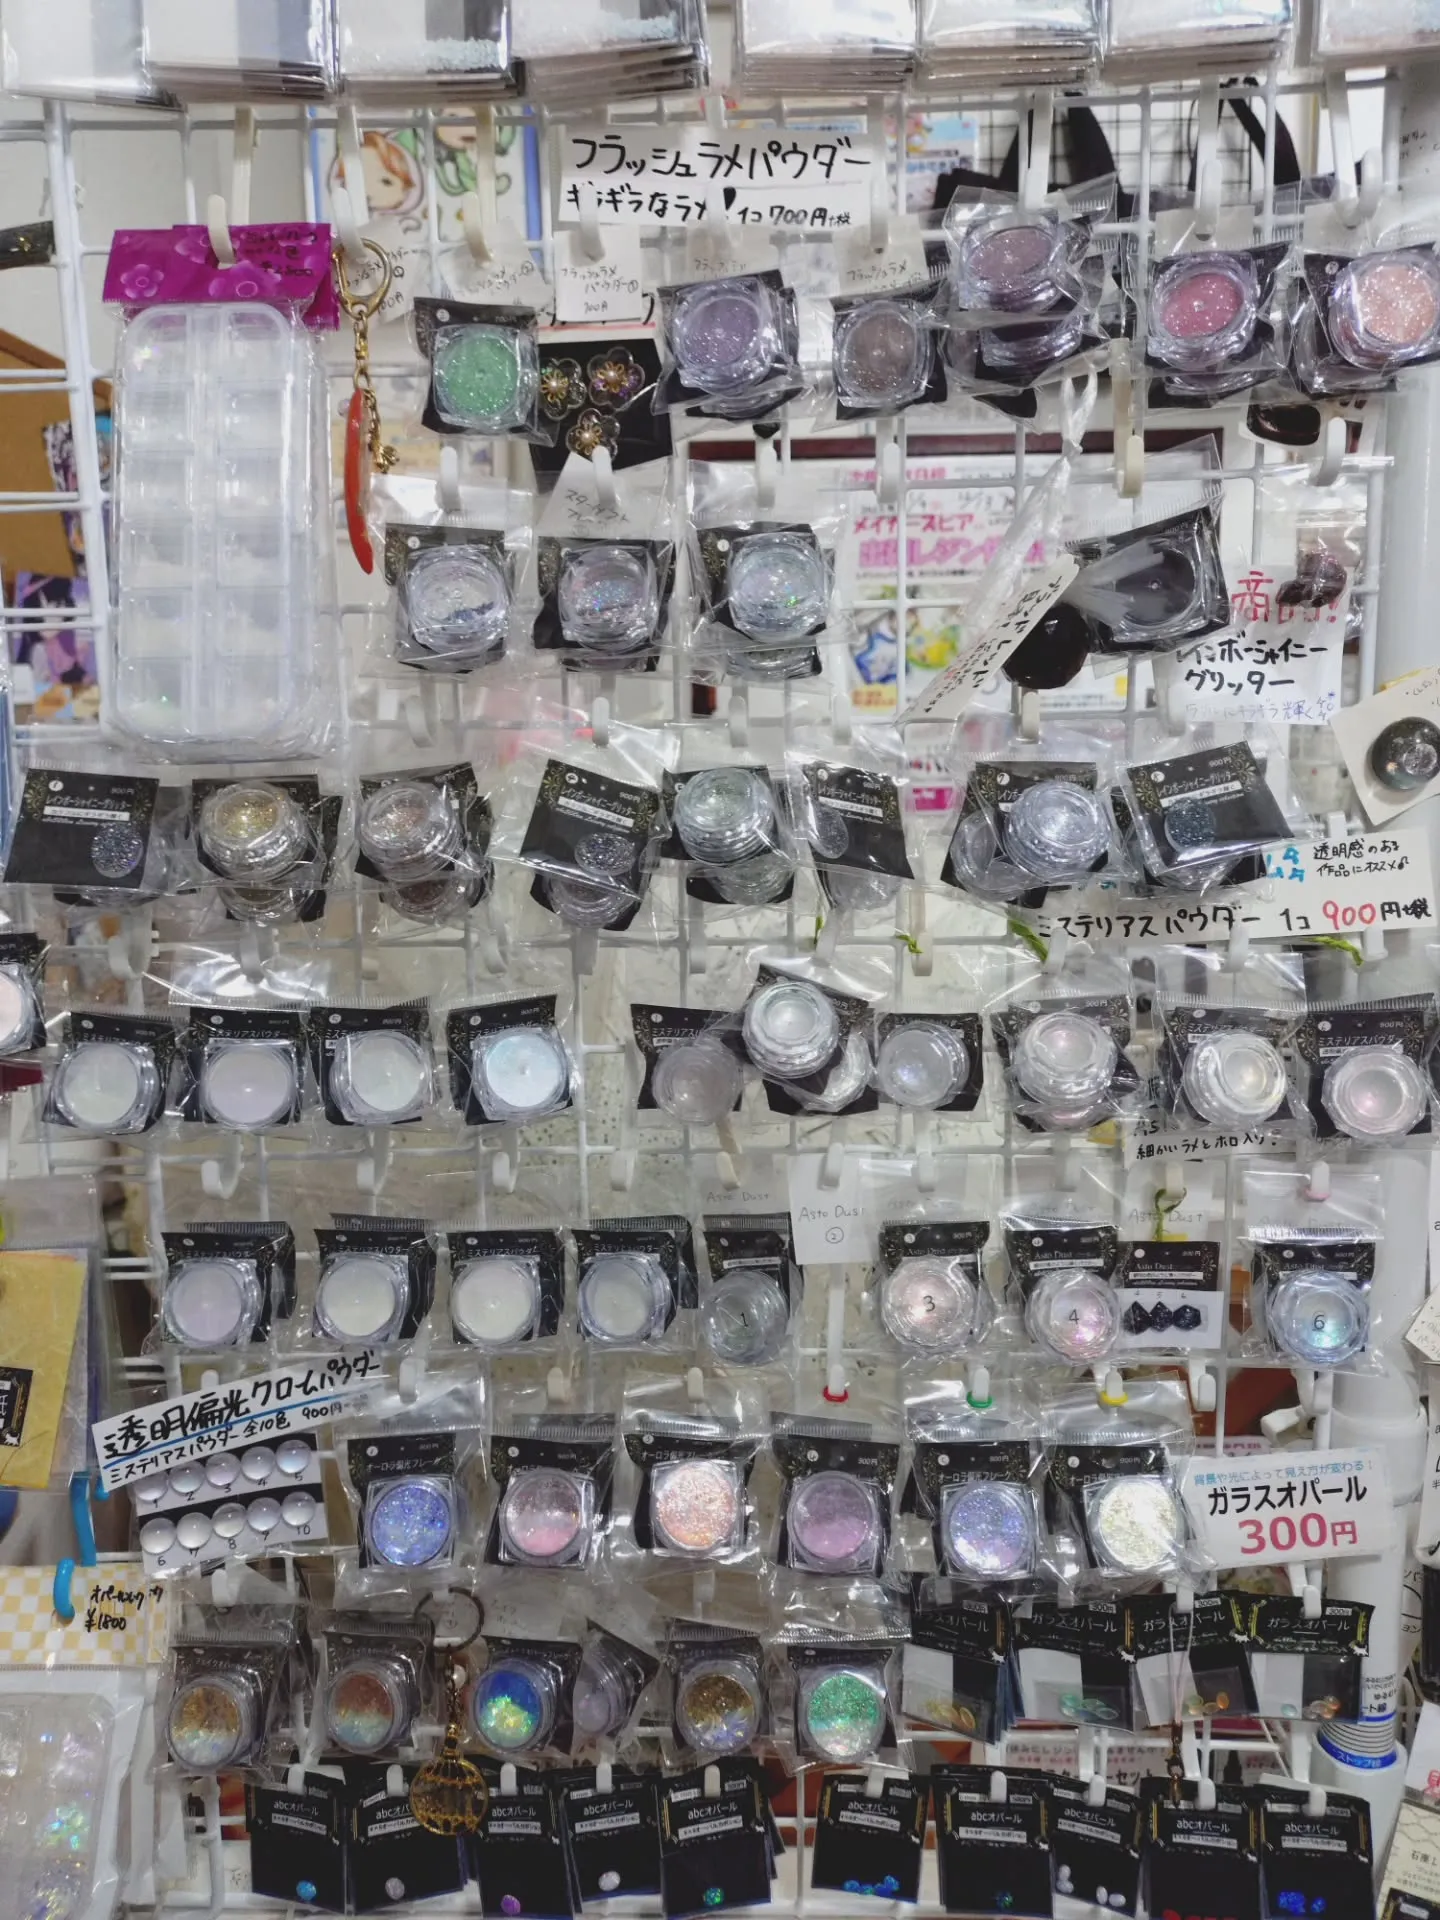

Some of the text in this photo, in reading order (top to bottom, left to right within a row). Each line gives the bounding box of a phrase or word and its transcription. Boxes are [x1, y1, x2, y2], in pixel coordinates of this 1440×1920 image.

[572, 134, 871, 180] フラッシュラメパウダー
[1184, 668, 1295, 695] グリッター
[1313, 839, 1400, 861] 透明感のある
[1038, 905, 1261, 938] ミステリアスパウダー
[922, 1296, 936, 1312] 3
[740, 1311, 748, 1327] 1
[1068, 1308, 1081, 1325] 4
[1312, 1314, 1326, 1333] 6
[104, 1350, 380, 1459] 透明偏光クロームパウダー
[110, 1424, 239, 1482] ミステリアスパウダー
[243, 1411, 290, 1438] 全10色
[224, 1483, 232, 1493] 3
[294, 1472, 304, 1482] 5
[1208, 1475, 1368, 1516] ガラスオパール
[1238, 1512, 1358, 1555] 300円
[157, 1556, 166, 1567] 6
[228, 1538, 237, 1550] 8
[296, 1525, 310, 1536] 10
[85, 1608, 126, 1632] ¥1800
[273, 1801, 319, 1816] abcオパール
[491, 1805, 537, 1818] abcオパール
[583, 1799, 634, 1816] abcオパール
[687, 1801, 738, 1819] abcオパール
[847, 1800, 898, 1816] abcオパール
[970, 1810, 1022, 1824] abcオパール
[1063, 1808, 1116, 1826] abcオパール
[1176, 1819, 1230, 1833] abcオパール
[1284, 1821, 1340, 1835] abcオパール
